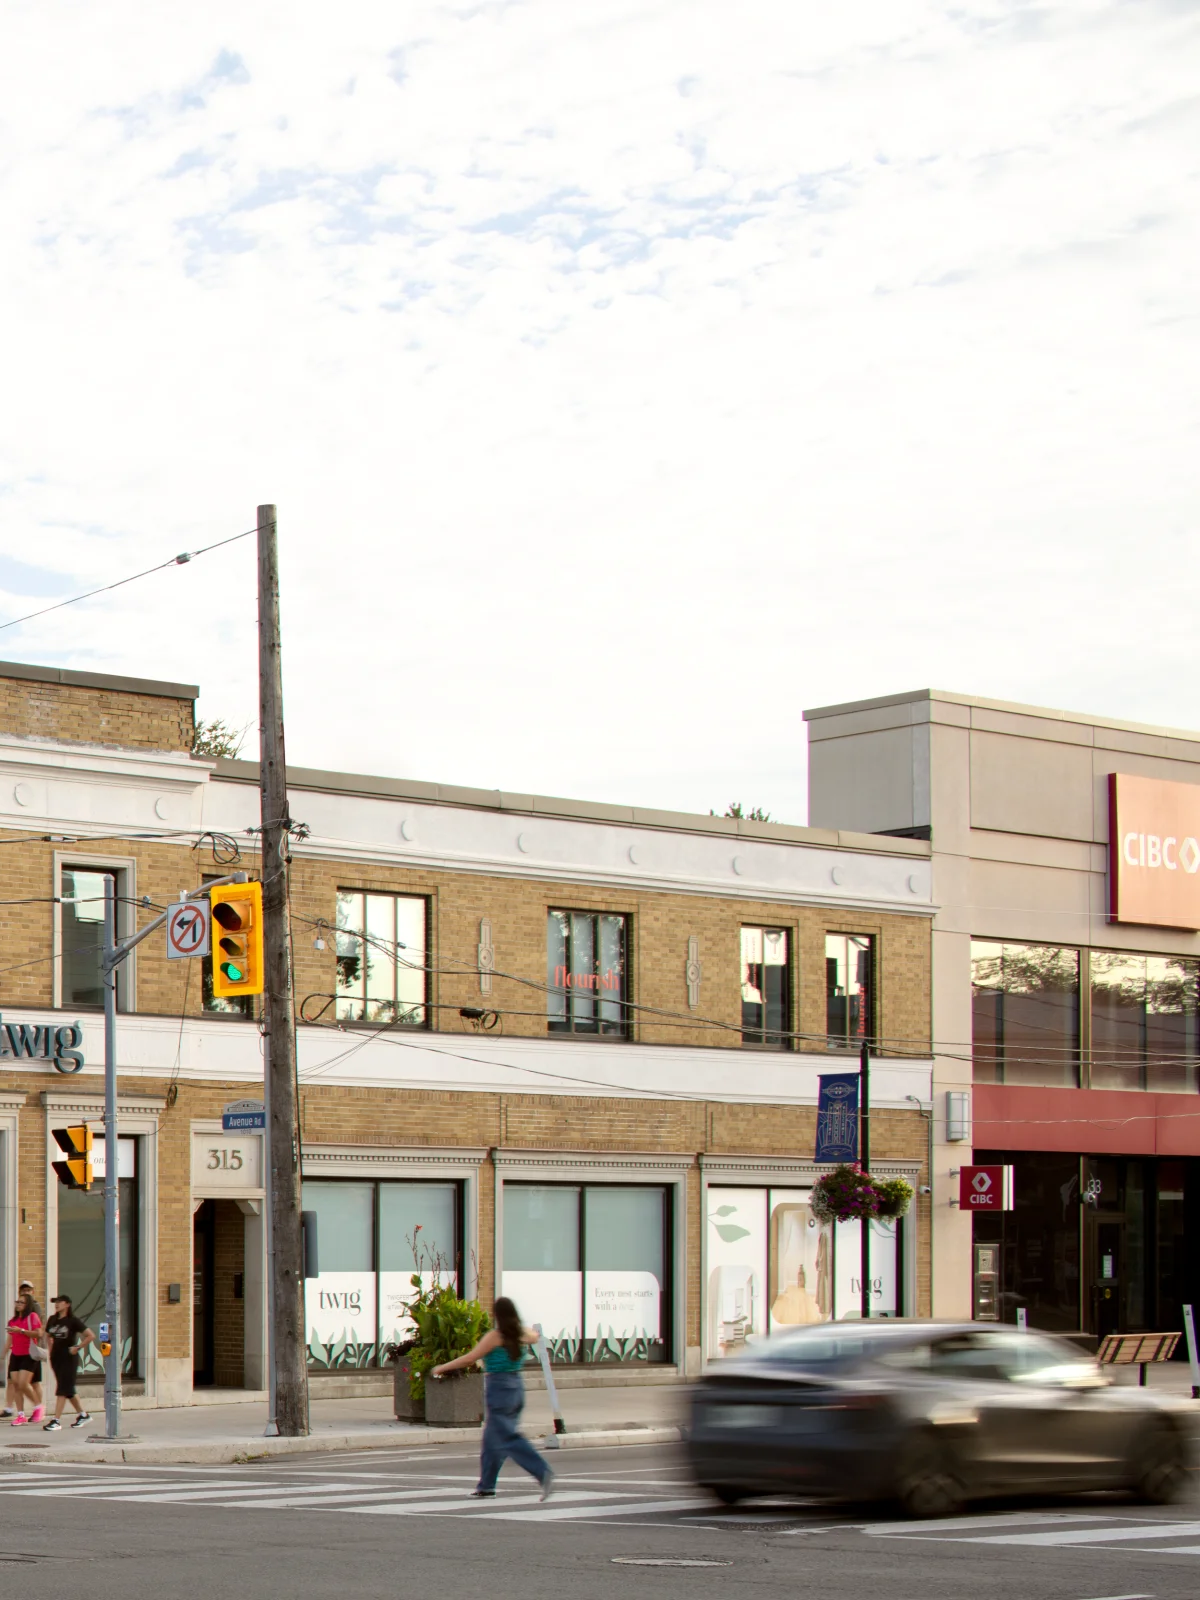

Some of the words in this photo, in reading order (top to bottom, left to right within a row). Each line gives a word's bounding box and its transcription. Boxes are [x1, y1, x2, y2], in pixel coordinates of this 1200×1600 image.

[1123, 832, 1177, 870] CIBC
[554, 961, 619, 990] flourish
[229, 1116, 253, 1127] Avenue
[207, 1149, 243, 1170] 315
[970, 1194, 993, 1204] CIBC
[318, 1288, 362, 1316] twig
